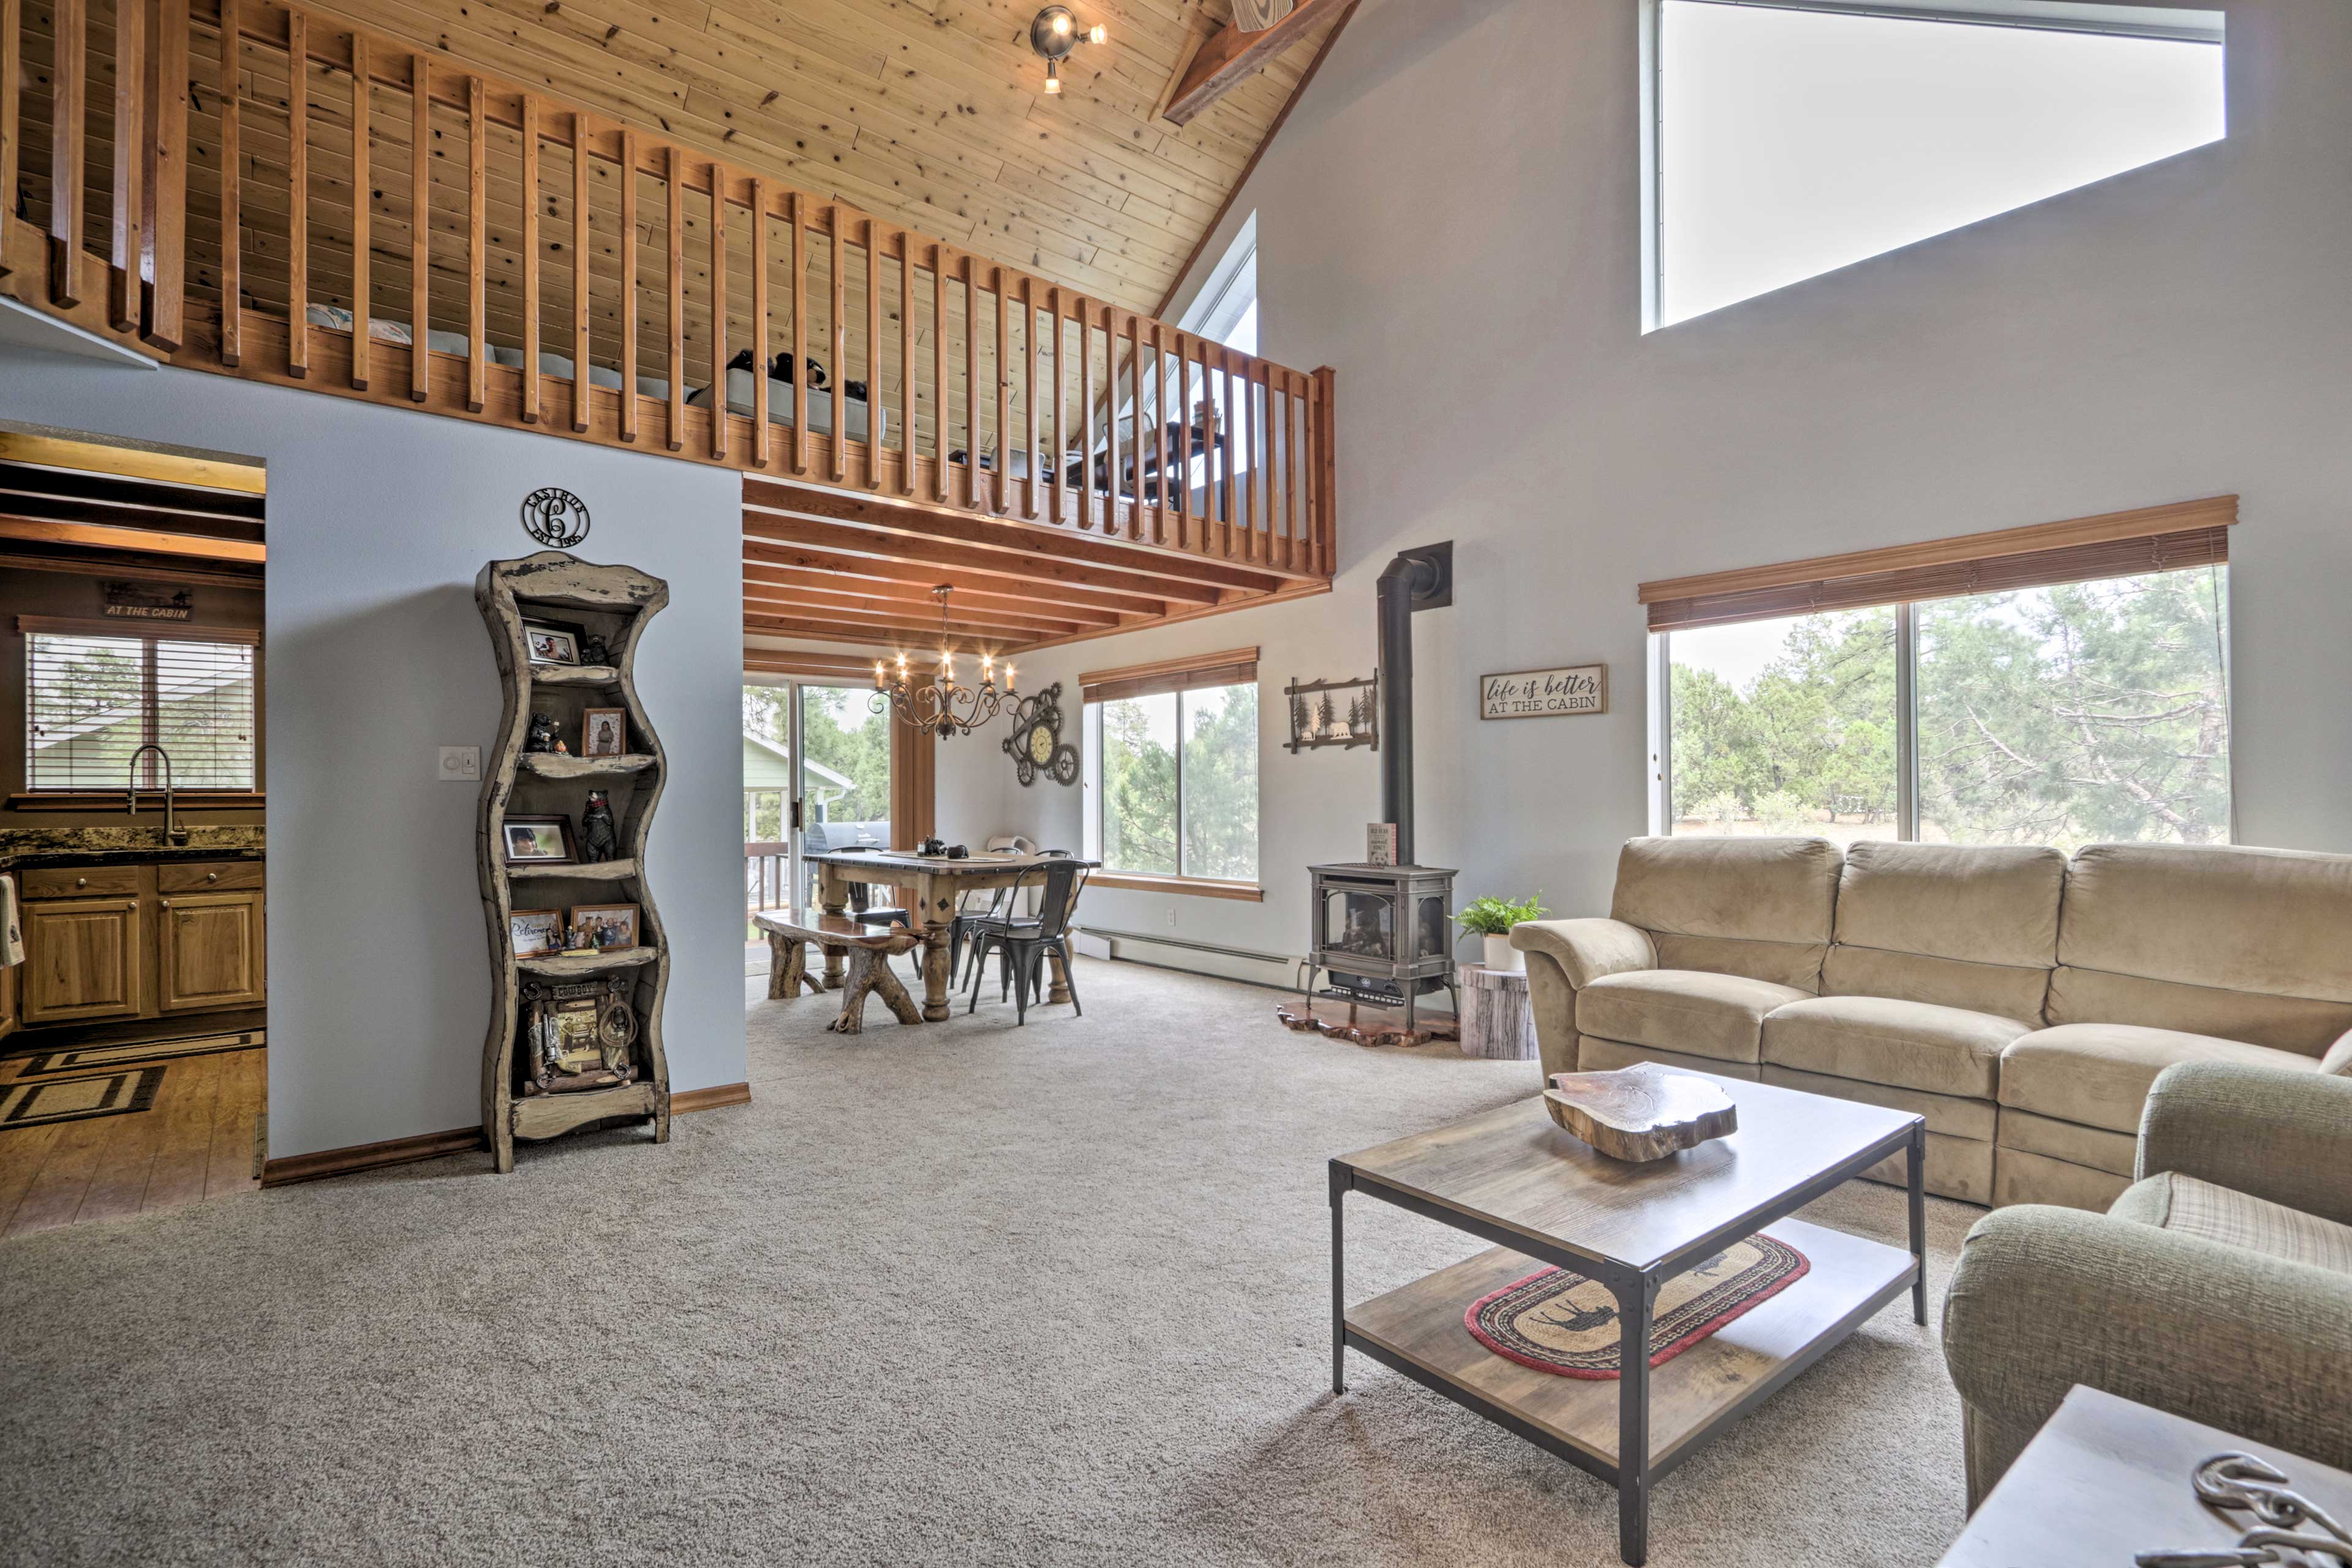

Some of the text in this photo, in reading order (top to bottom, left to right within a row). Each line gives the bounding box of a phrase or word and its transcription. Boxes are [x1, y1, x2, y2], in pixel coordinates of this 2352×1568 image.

[527, 488, 585, 513] CASTROS
[560, 533, 583, 548] 1995
[107, 606, 188, 619] AT THE CABIN
[1487, 674, 1602, 701] life is better
[1488, 696, 1596, 714] AT THE CABIN
[559, 985, 592, 997] COWBOY
